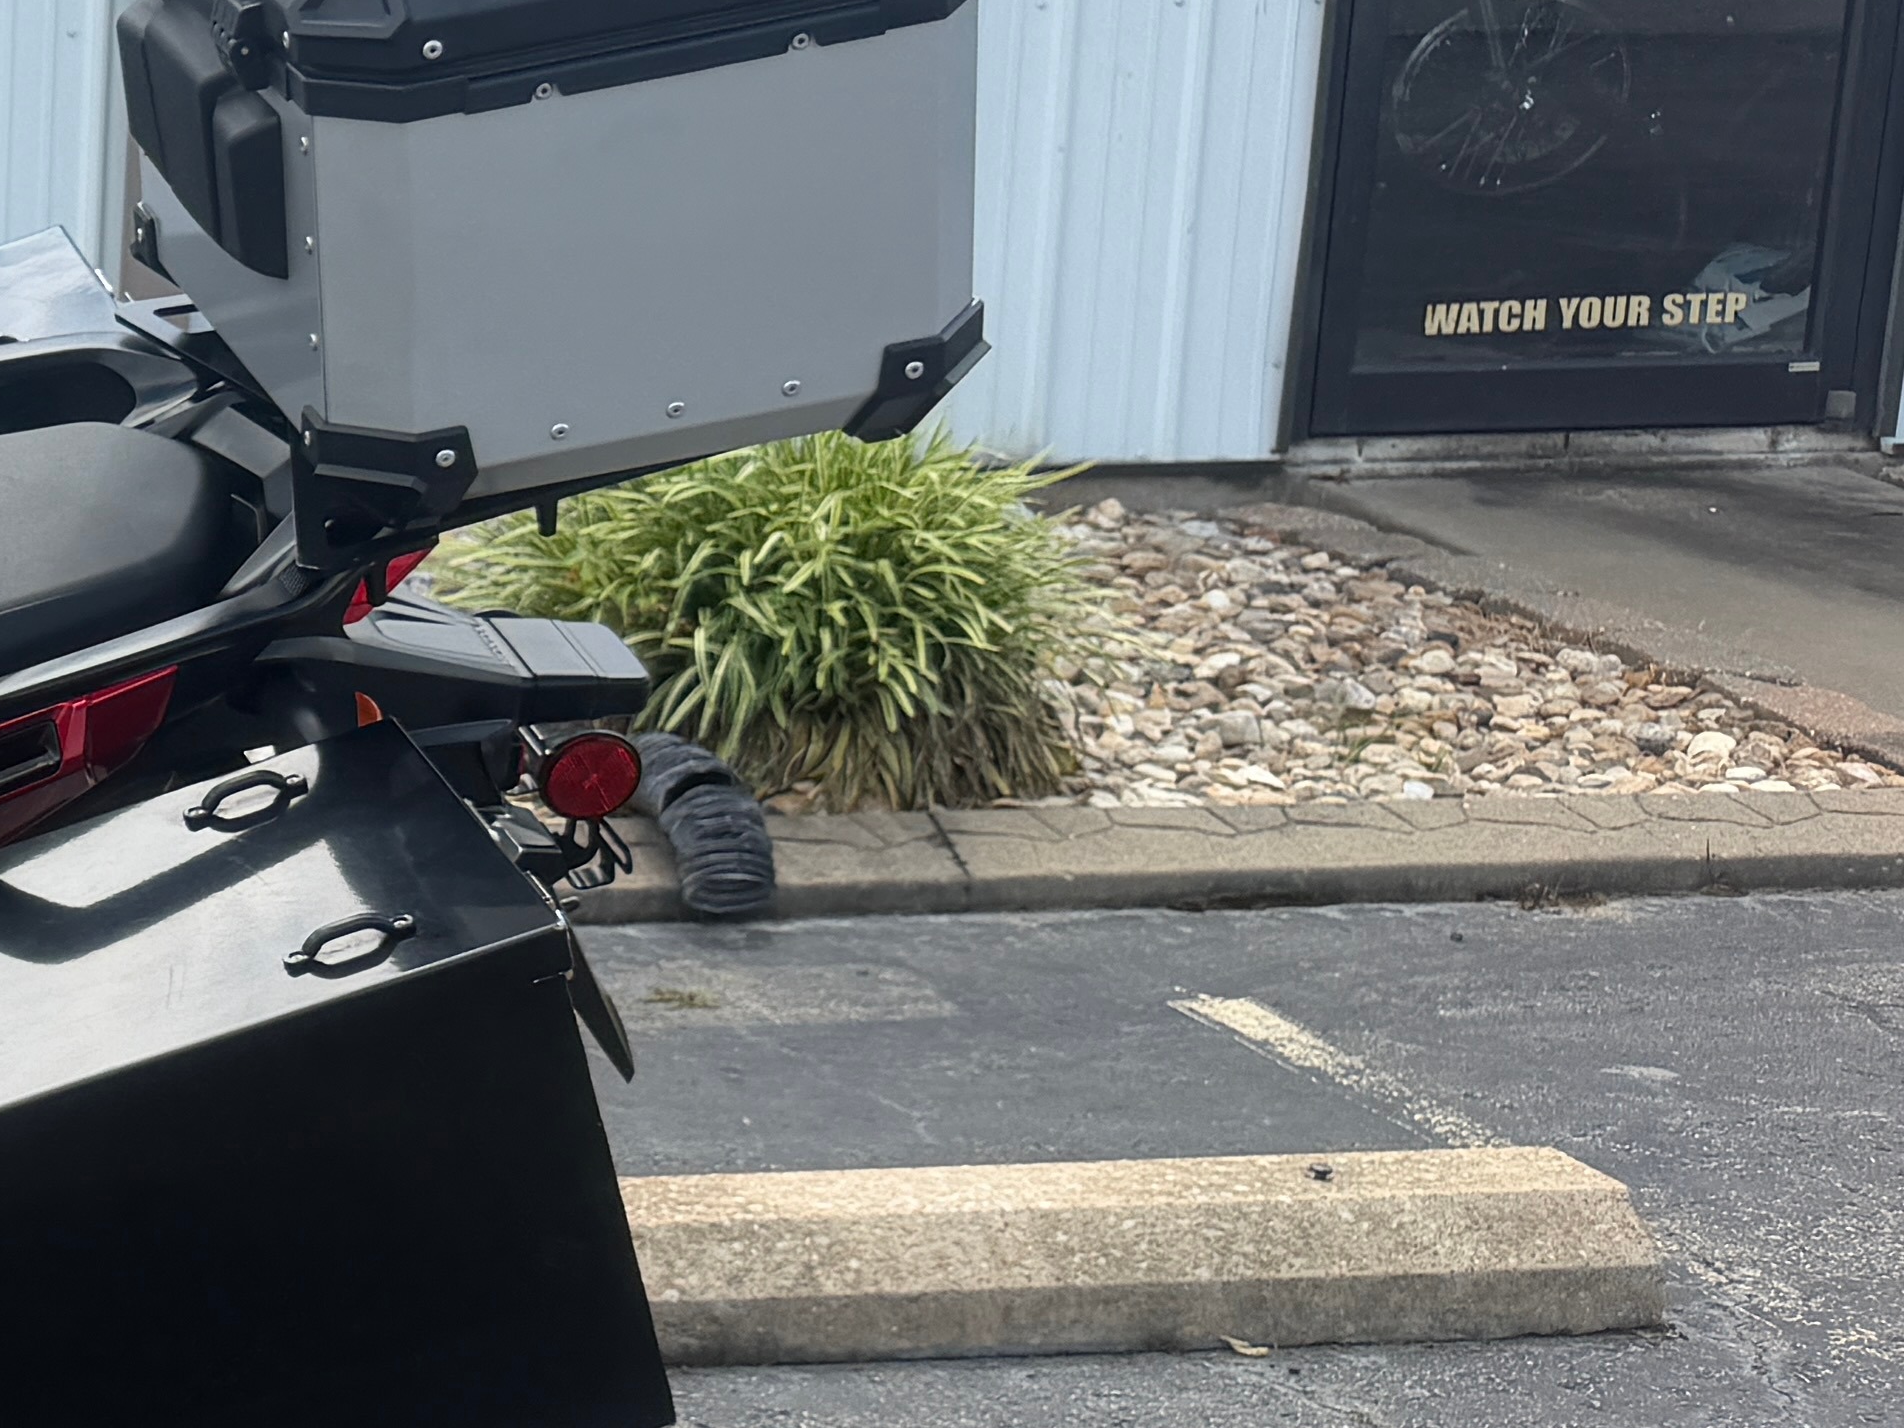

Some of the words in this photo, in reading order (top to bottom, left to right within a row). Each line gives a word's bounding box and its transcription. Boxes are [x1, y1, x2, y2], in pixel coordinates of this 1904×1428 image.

[1424, 299, 1547, 336] WATCH
[1558, 295, 1651, 329] YOUR
[1661, 292, 1747, 327] STEP
